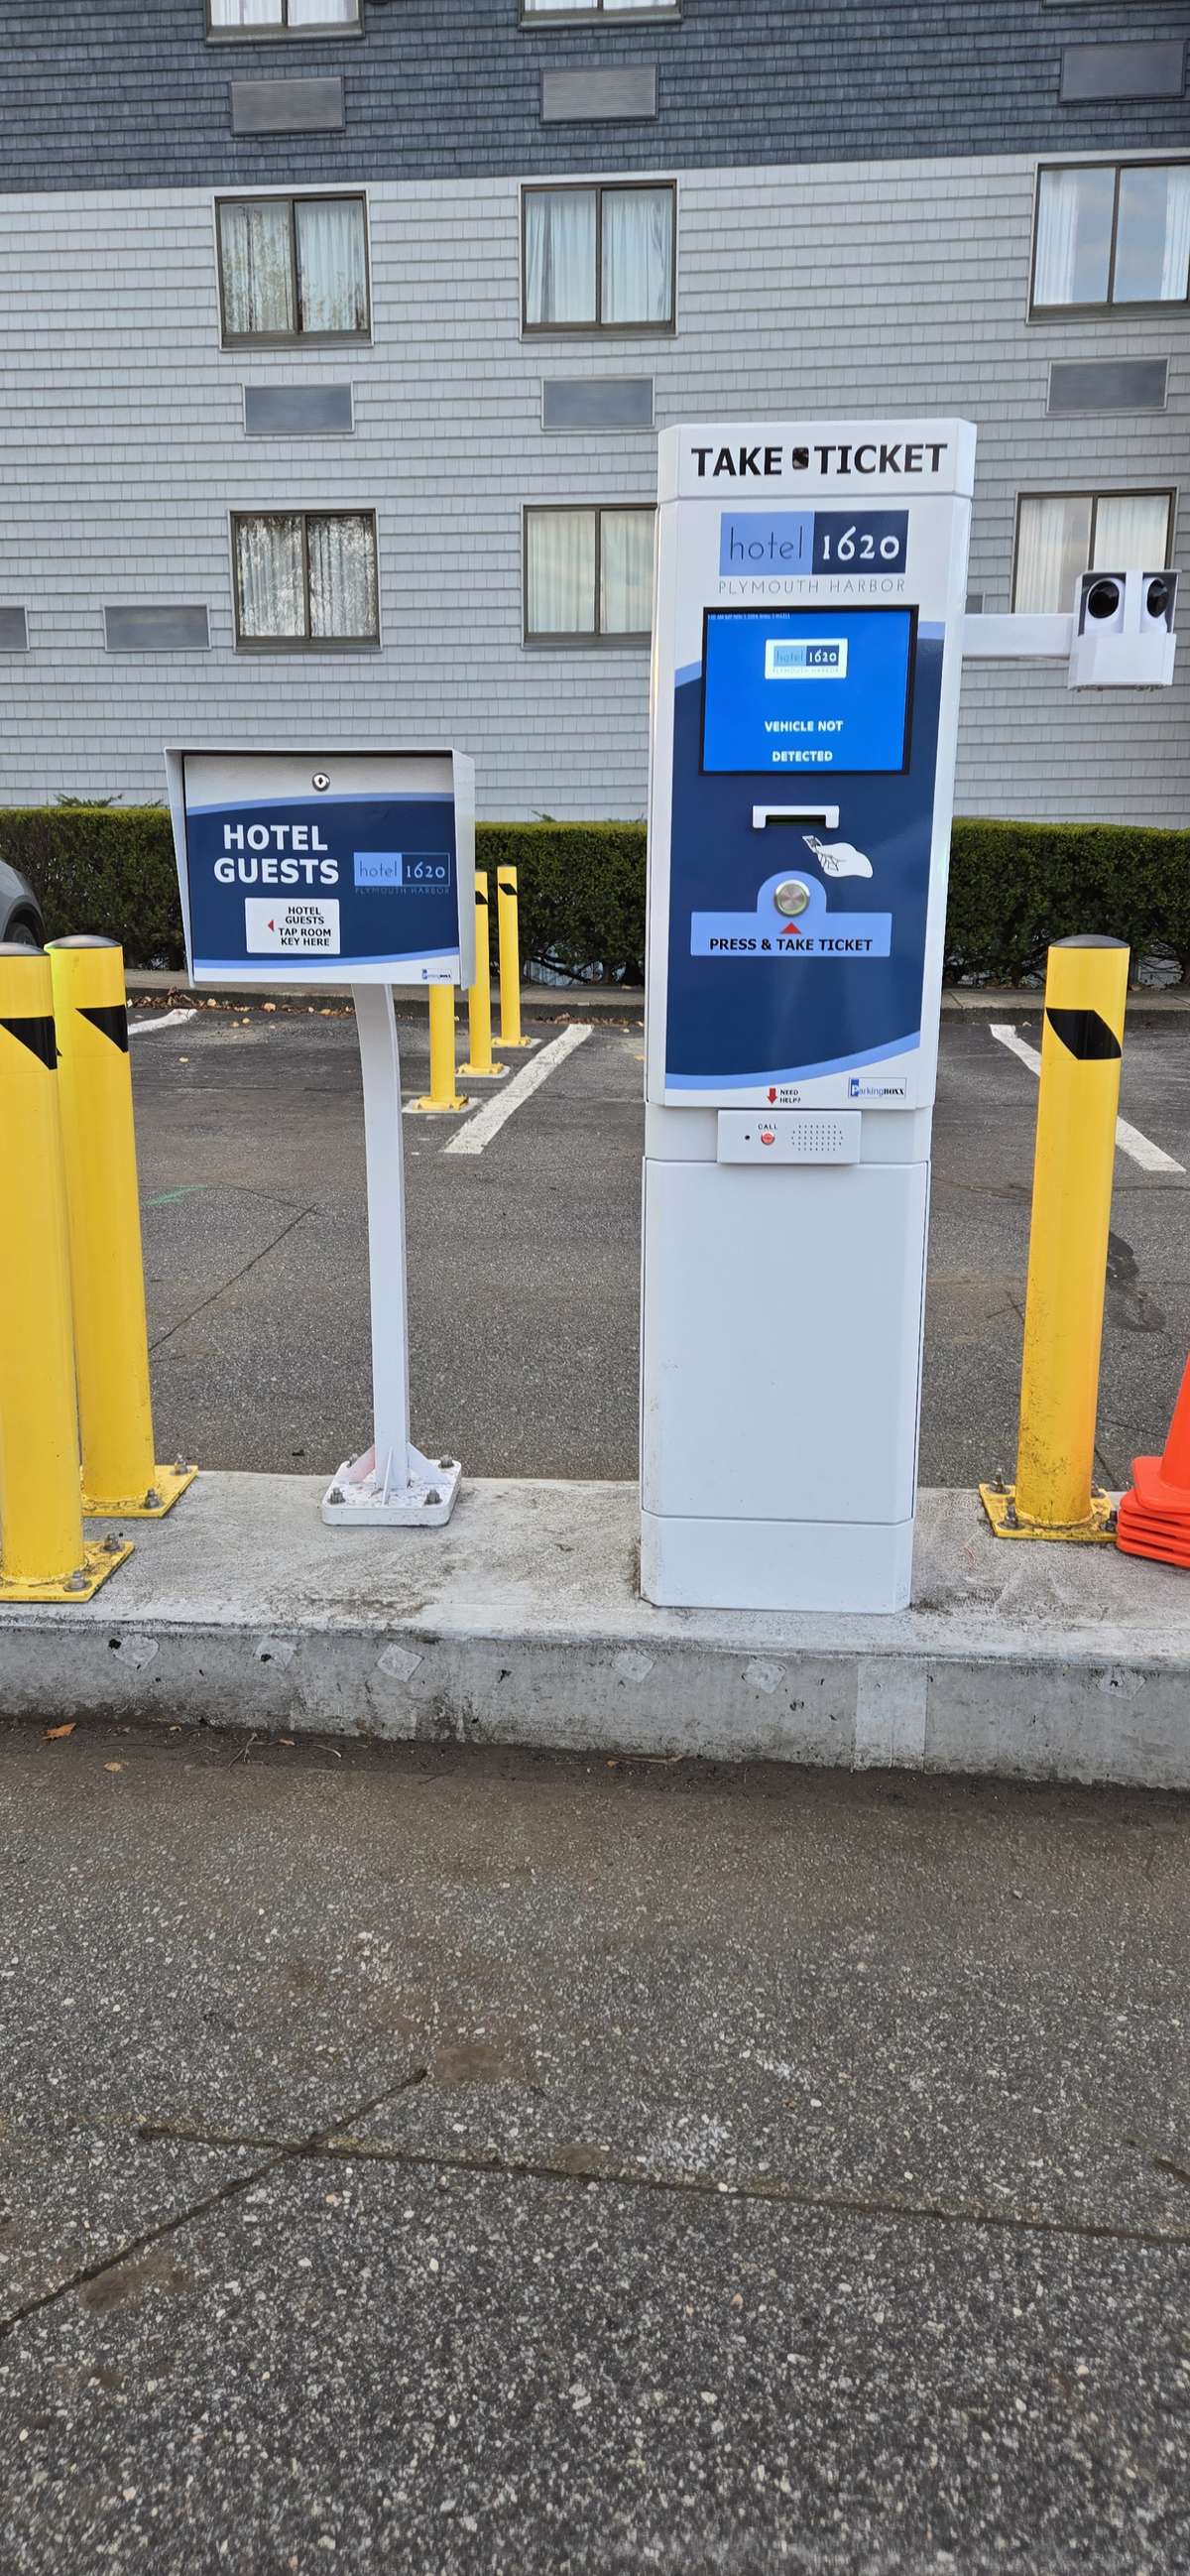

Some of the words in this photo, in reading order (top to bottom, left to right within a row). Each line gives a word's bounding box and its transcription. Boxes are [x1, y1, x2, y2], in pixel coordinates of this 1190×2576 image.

[691, 446, 783, 477] TAKE
[814, 443, 948, 475] TICKET
[729, 525, 803, 560] hotel
[823, 526, 899, 561] 1620
[718, 579, 819, 595] PLYMOUTH
[829, 578, 905, 592] HARBOR
[809, 649, 837, 664] 1620
[764, 720, 814, 733] VEHICLE
[817, 720, 844, 732] NOT
[772, 750, 833, 763] DETECTED
[223, 824, 328, 851] HOTEL
[213, 857, 339, 884] GUESTS
[359, 860, 398, 879] hotel
[406, 861, 445, 879] 1620
[288, 906, 321, 916] HOTEL
[285, 916, 325, 924] GUESTS
[279, 927, 298, 936] TAP
[300, 928, 332, 937] ROOM
[281, 937, 300, 946] KEY
[302, 937, 330, 946] HERE
[709, 938, 757, 950] PRESS
[761, 938, 772, 950] &
[776, 939, 814, 950] TAKE
[818, 939, 873, 950] TICKET
